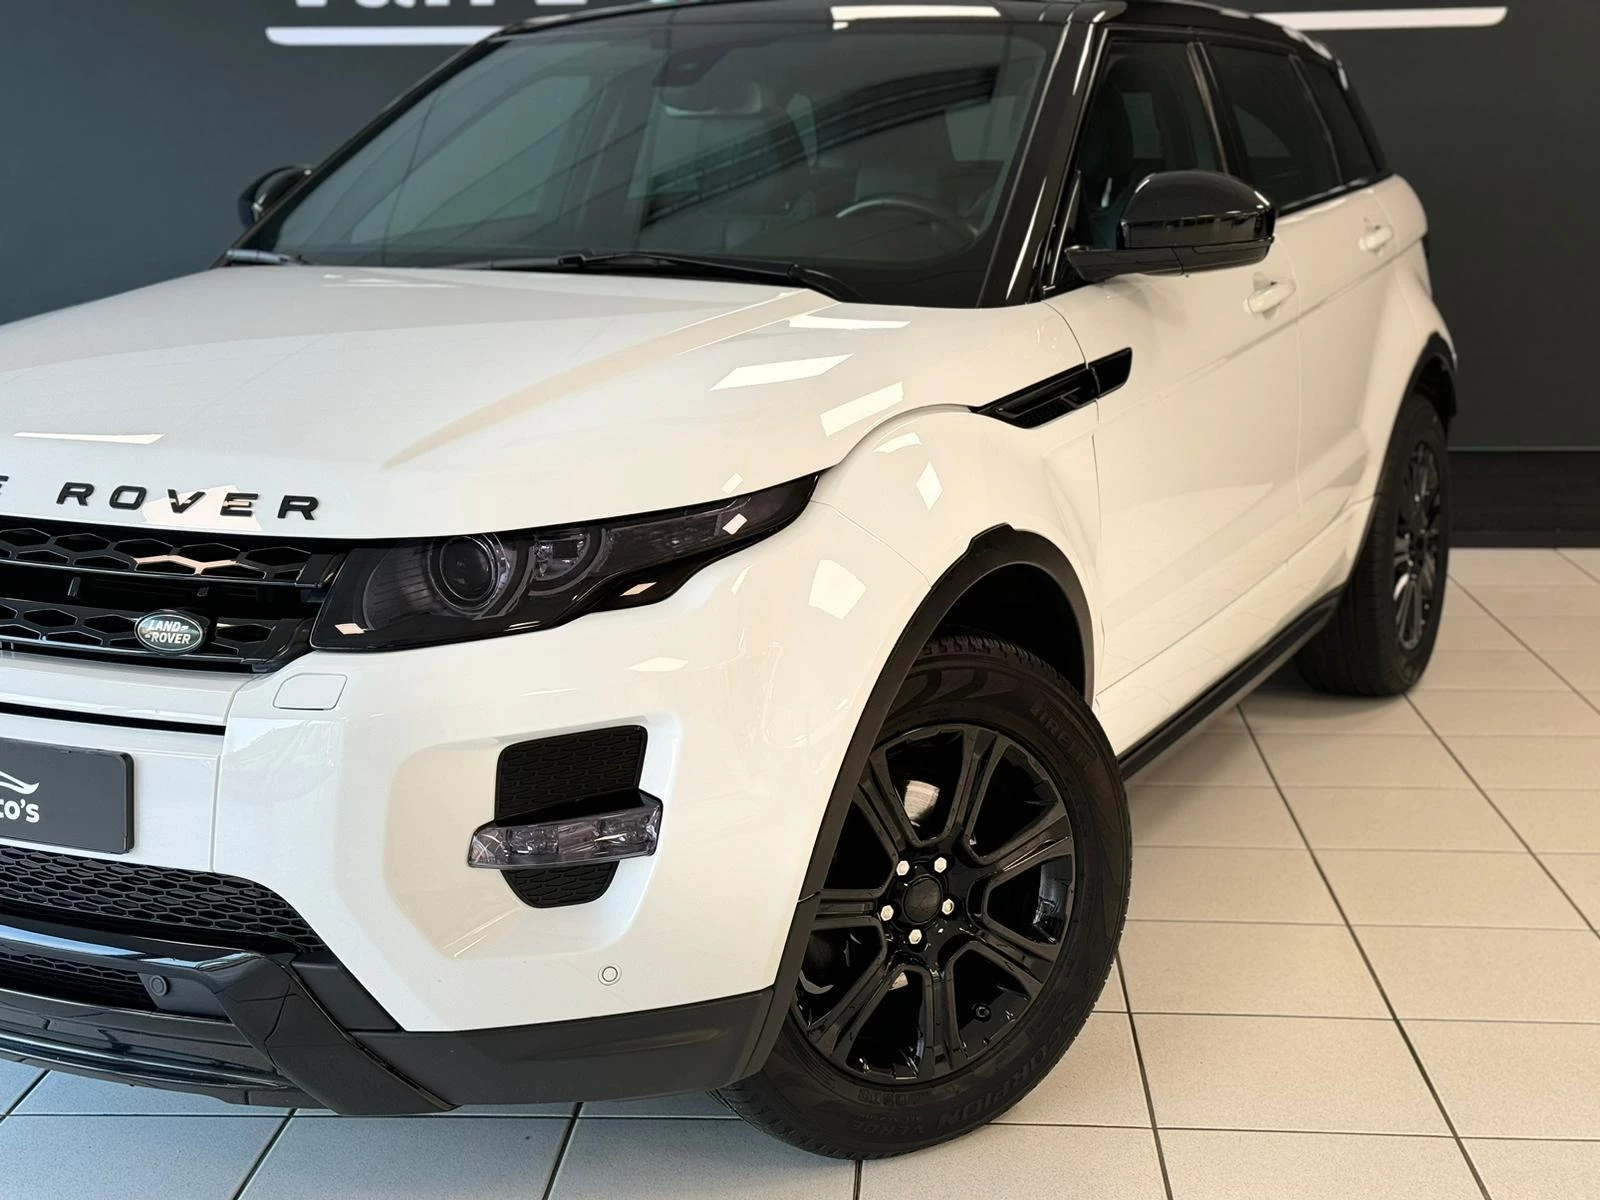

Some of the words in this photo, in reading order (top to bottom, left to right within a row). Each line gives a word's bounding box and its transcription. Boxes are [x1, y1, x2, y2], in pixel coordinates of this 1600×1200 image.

[56, 481, 320, 521] ROVER
[148, 619, 182, 632] LAND
[150, 631, 191, 645] ROVER
